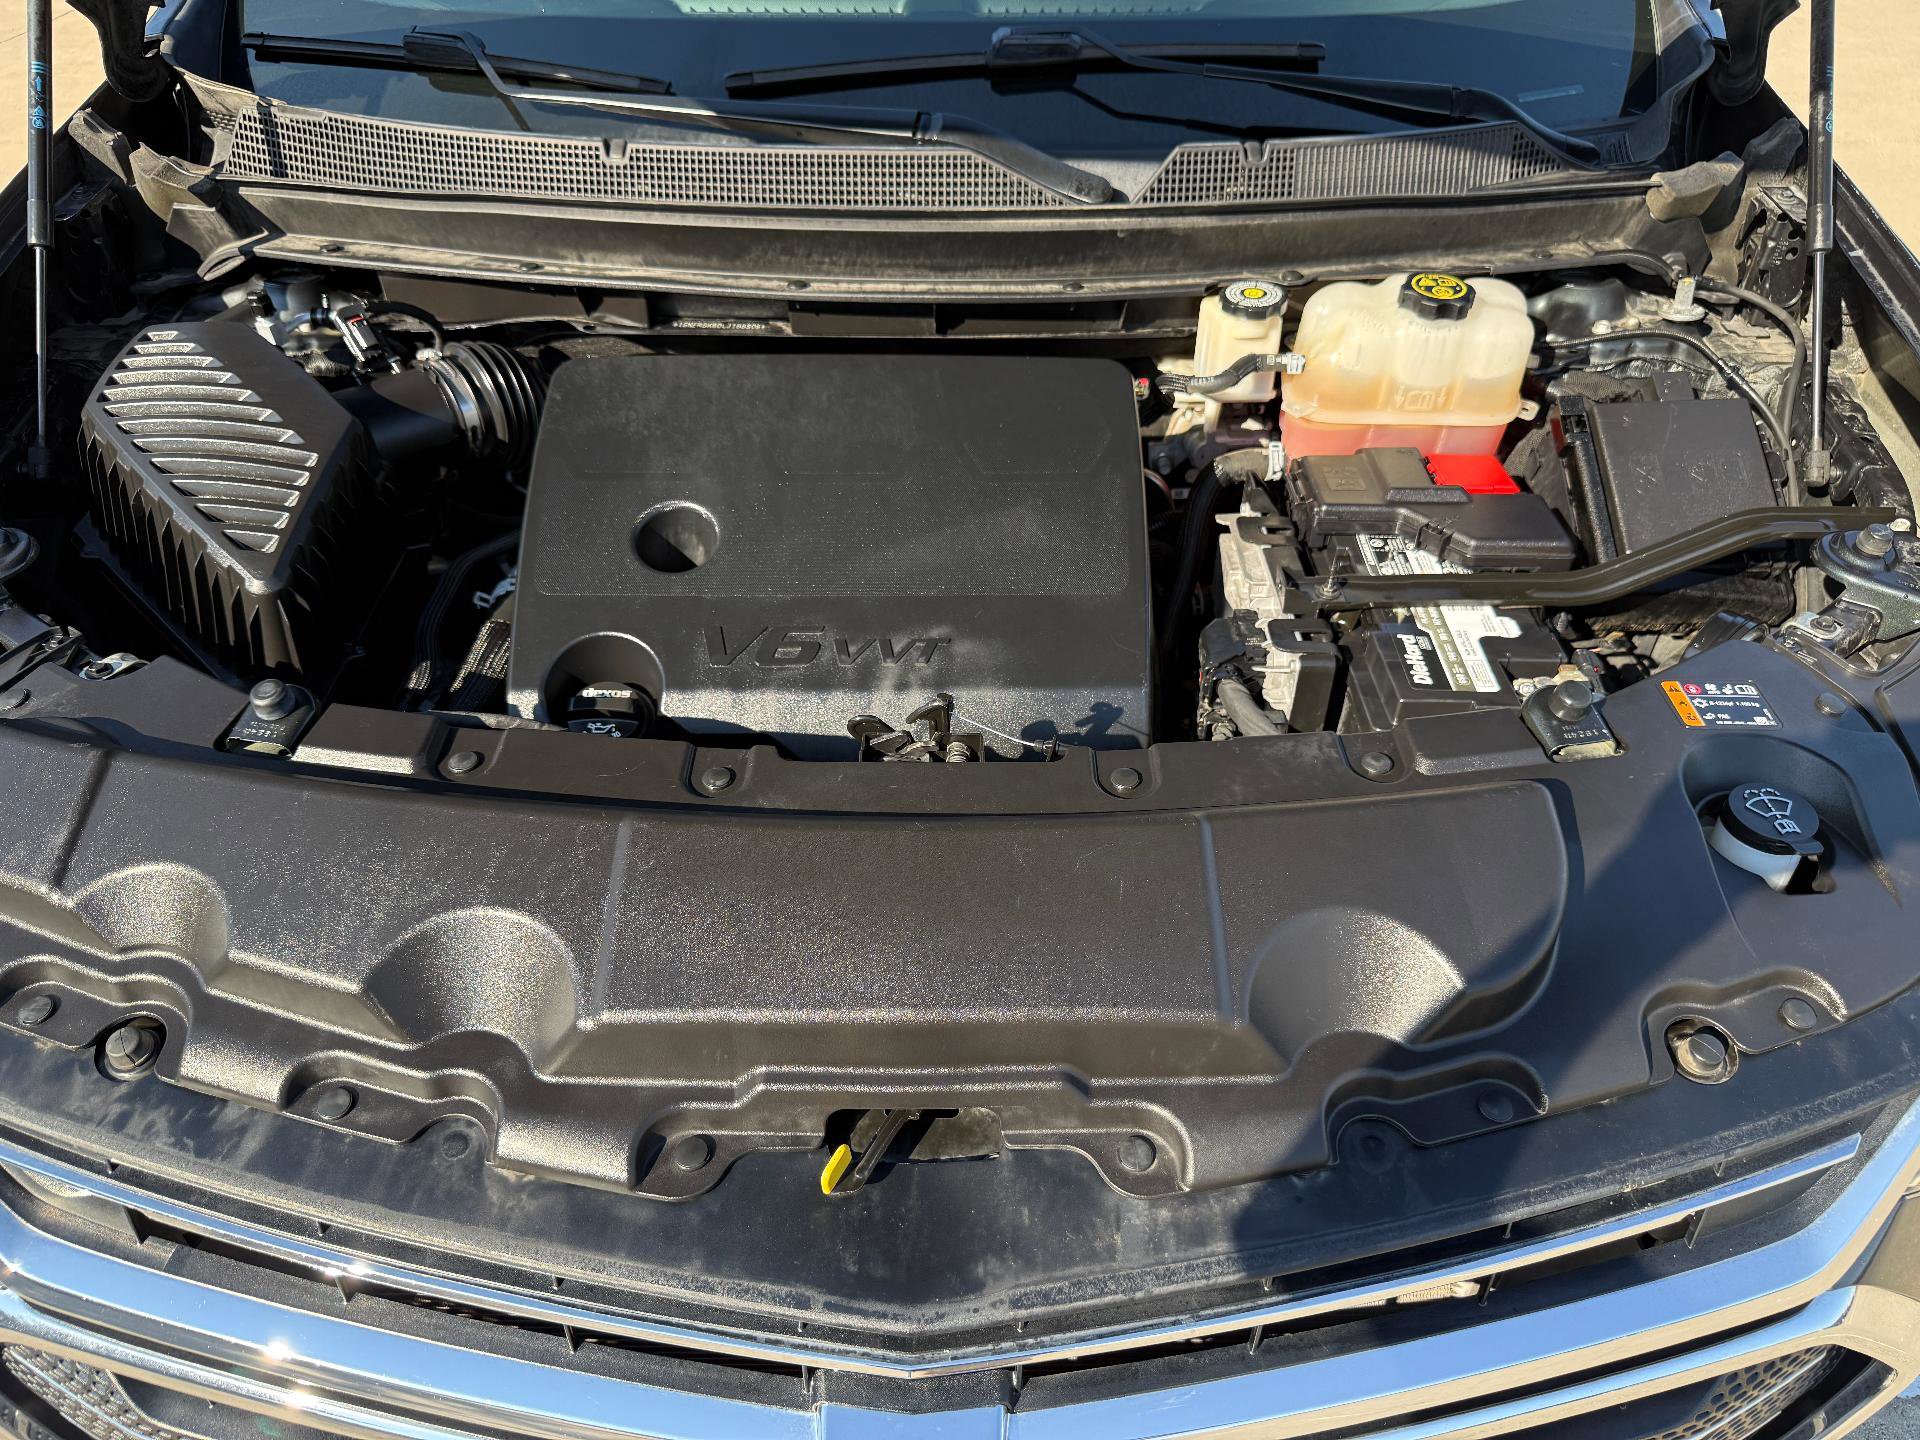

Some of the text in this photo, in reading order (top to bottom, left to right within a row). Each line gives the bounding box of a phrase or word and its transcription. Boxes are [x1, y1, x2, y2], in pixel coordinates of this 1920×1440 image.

[703, 625, 951, 667] V6 VVT
[1397, 633, 1433, 685] DieHard
[582, 688, 632, 697] dexos
